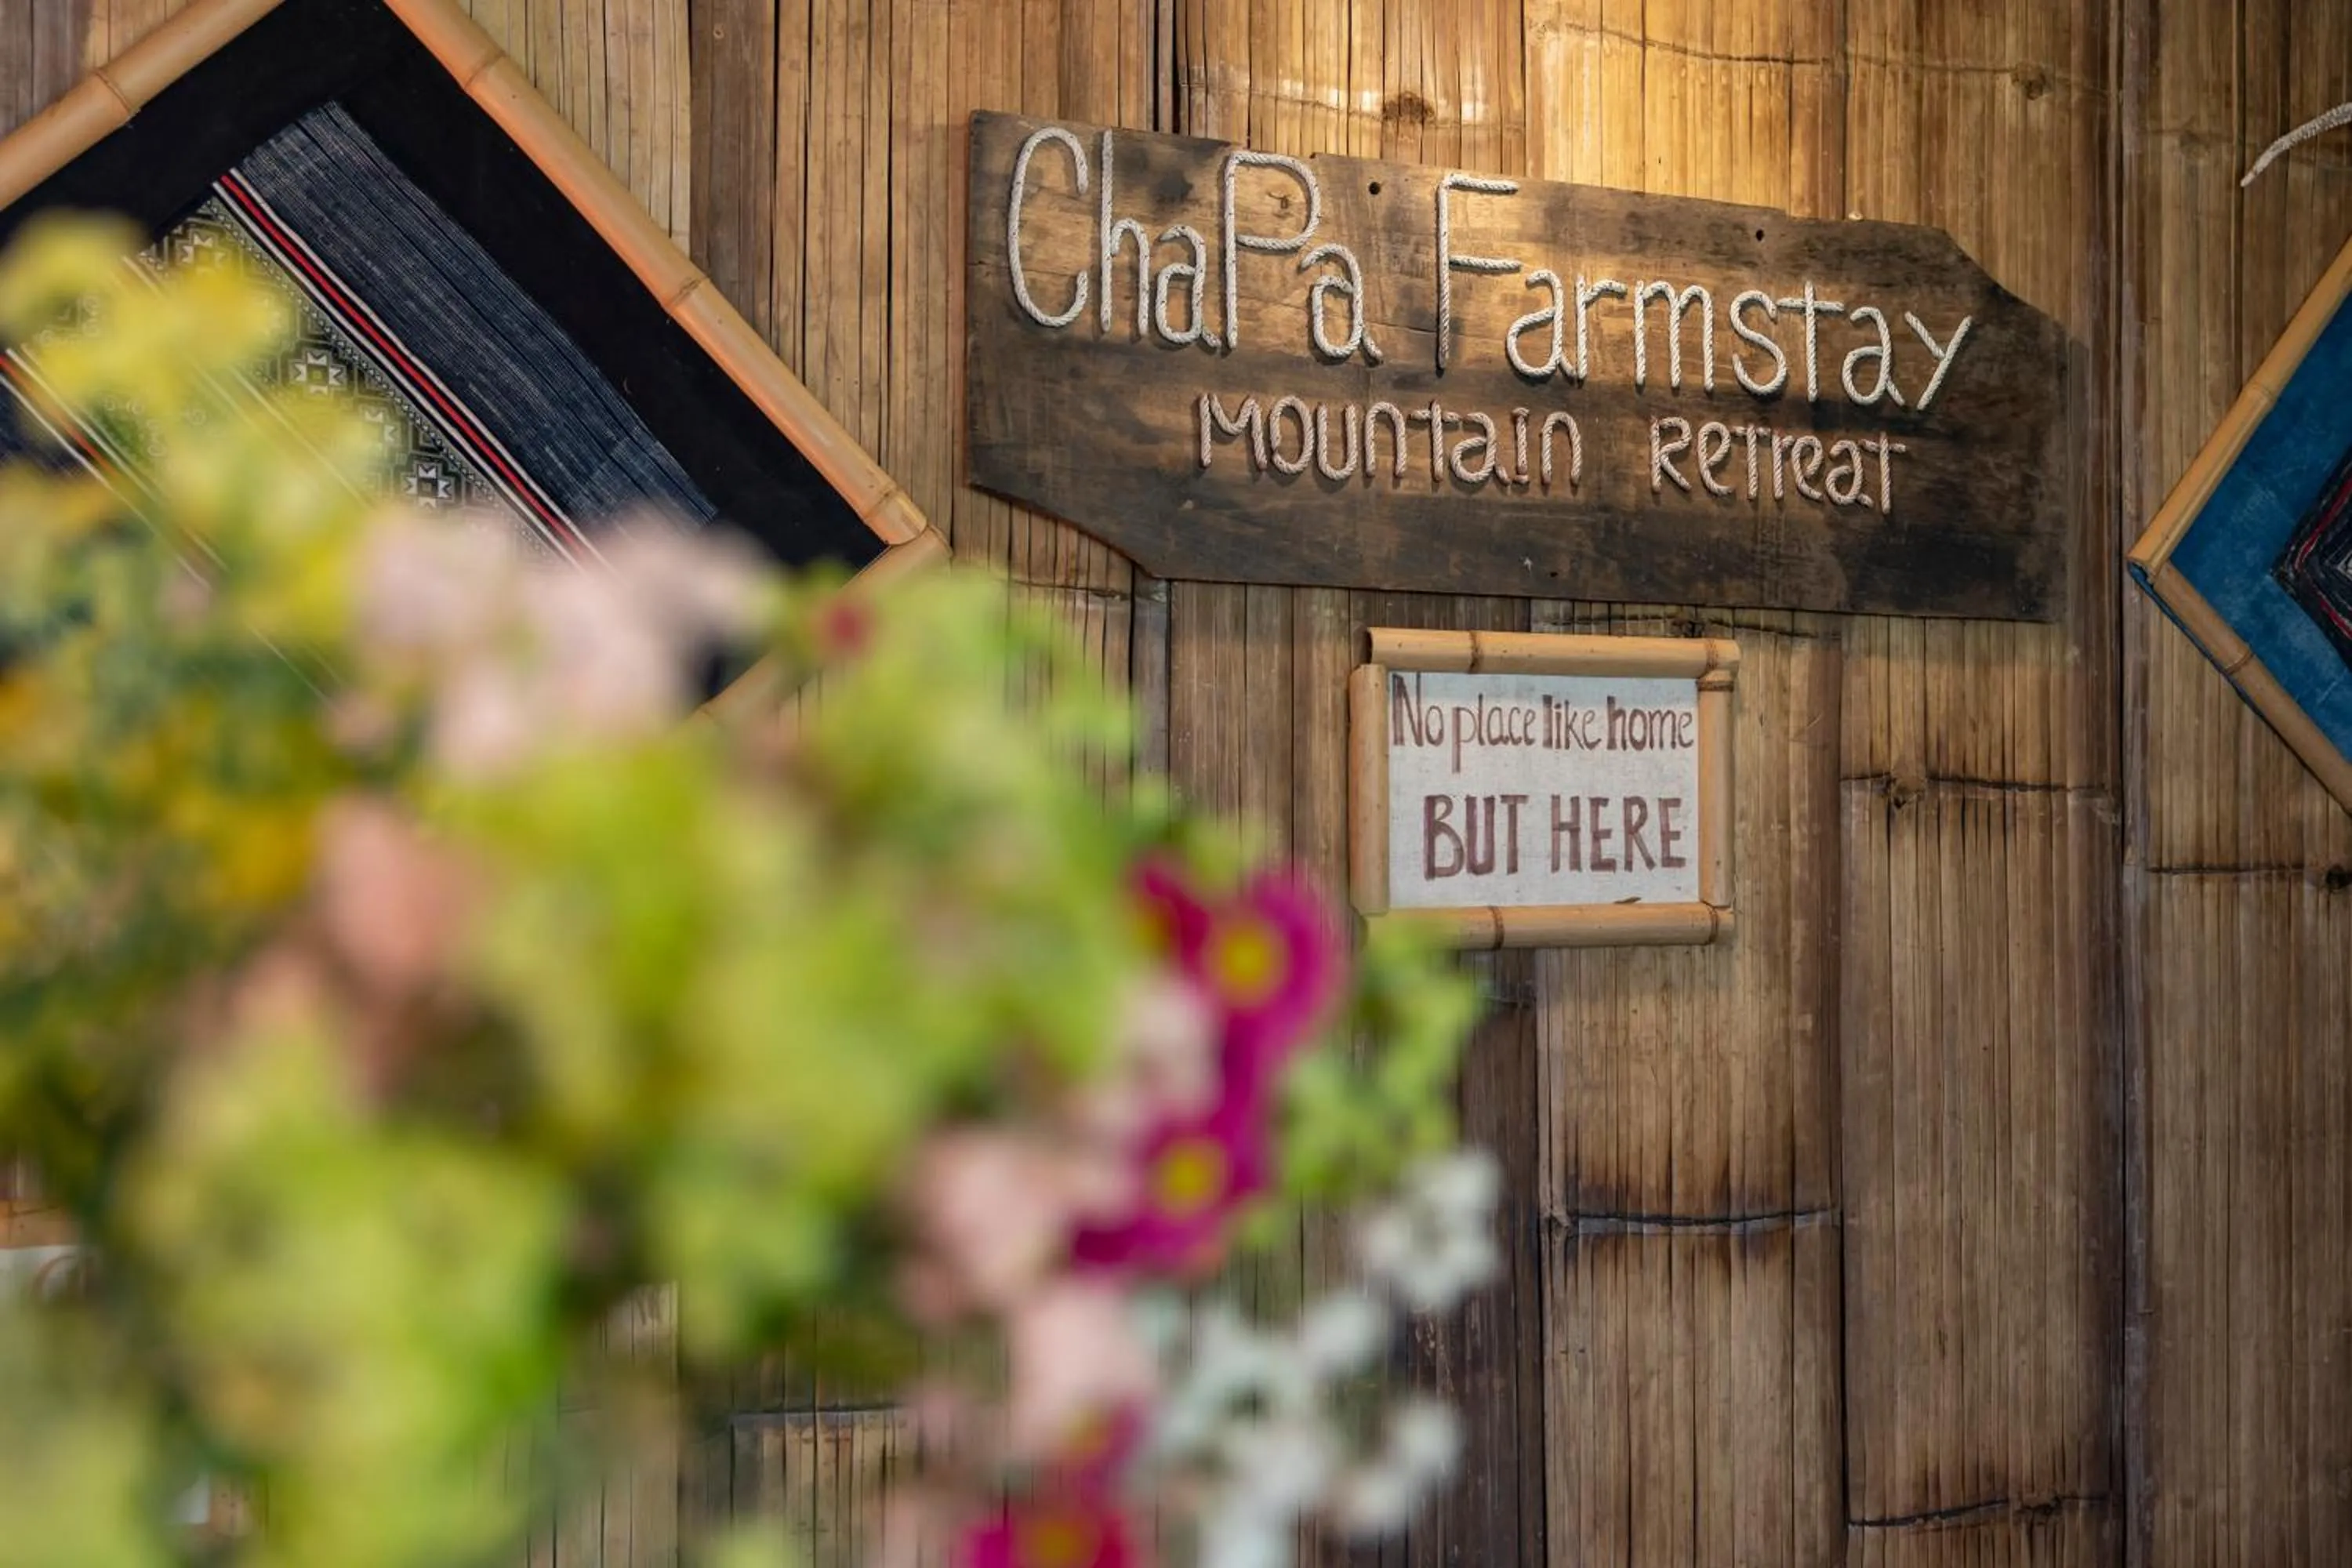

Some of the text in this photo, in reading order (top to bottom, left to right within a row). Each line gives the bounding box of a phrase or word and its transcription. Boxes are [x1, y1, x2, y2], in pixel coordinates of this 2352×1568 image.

[1008, 127, 1972, 412] ChaPa Farmstay
[1392, 672, 1694, 774] No place like home
[1424, 793, 1687, 880] BUT HERE
